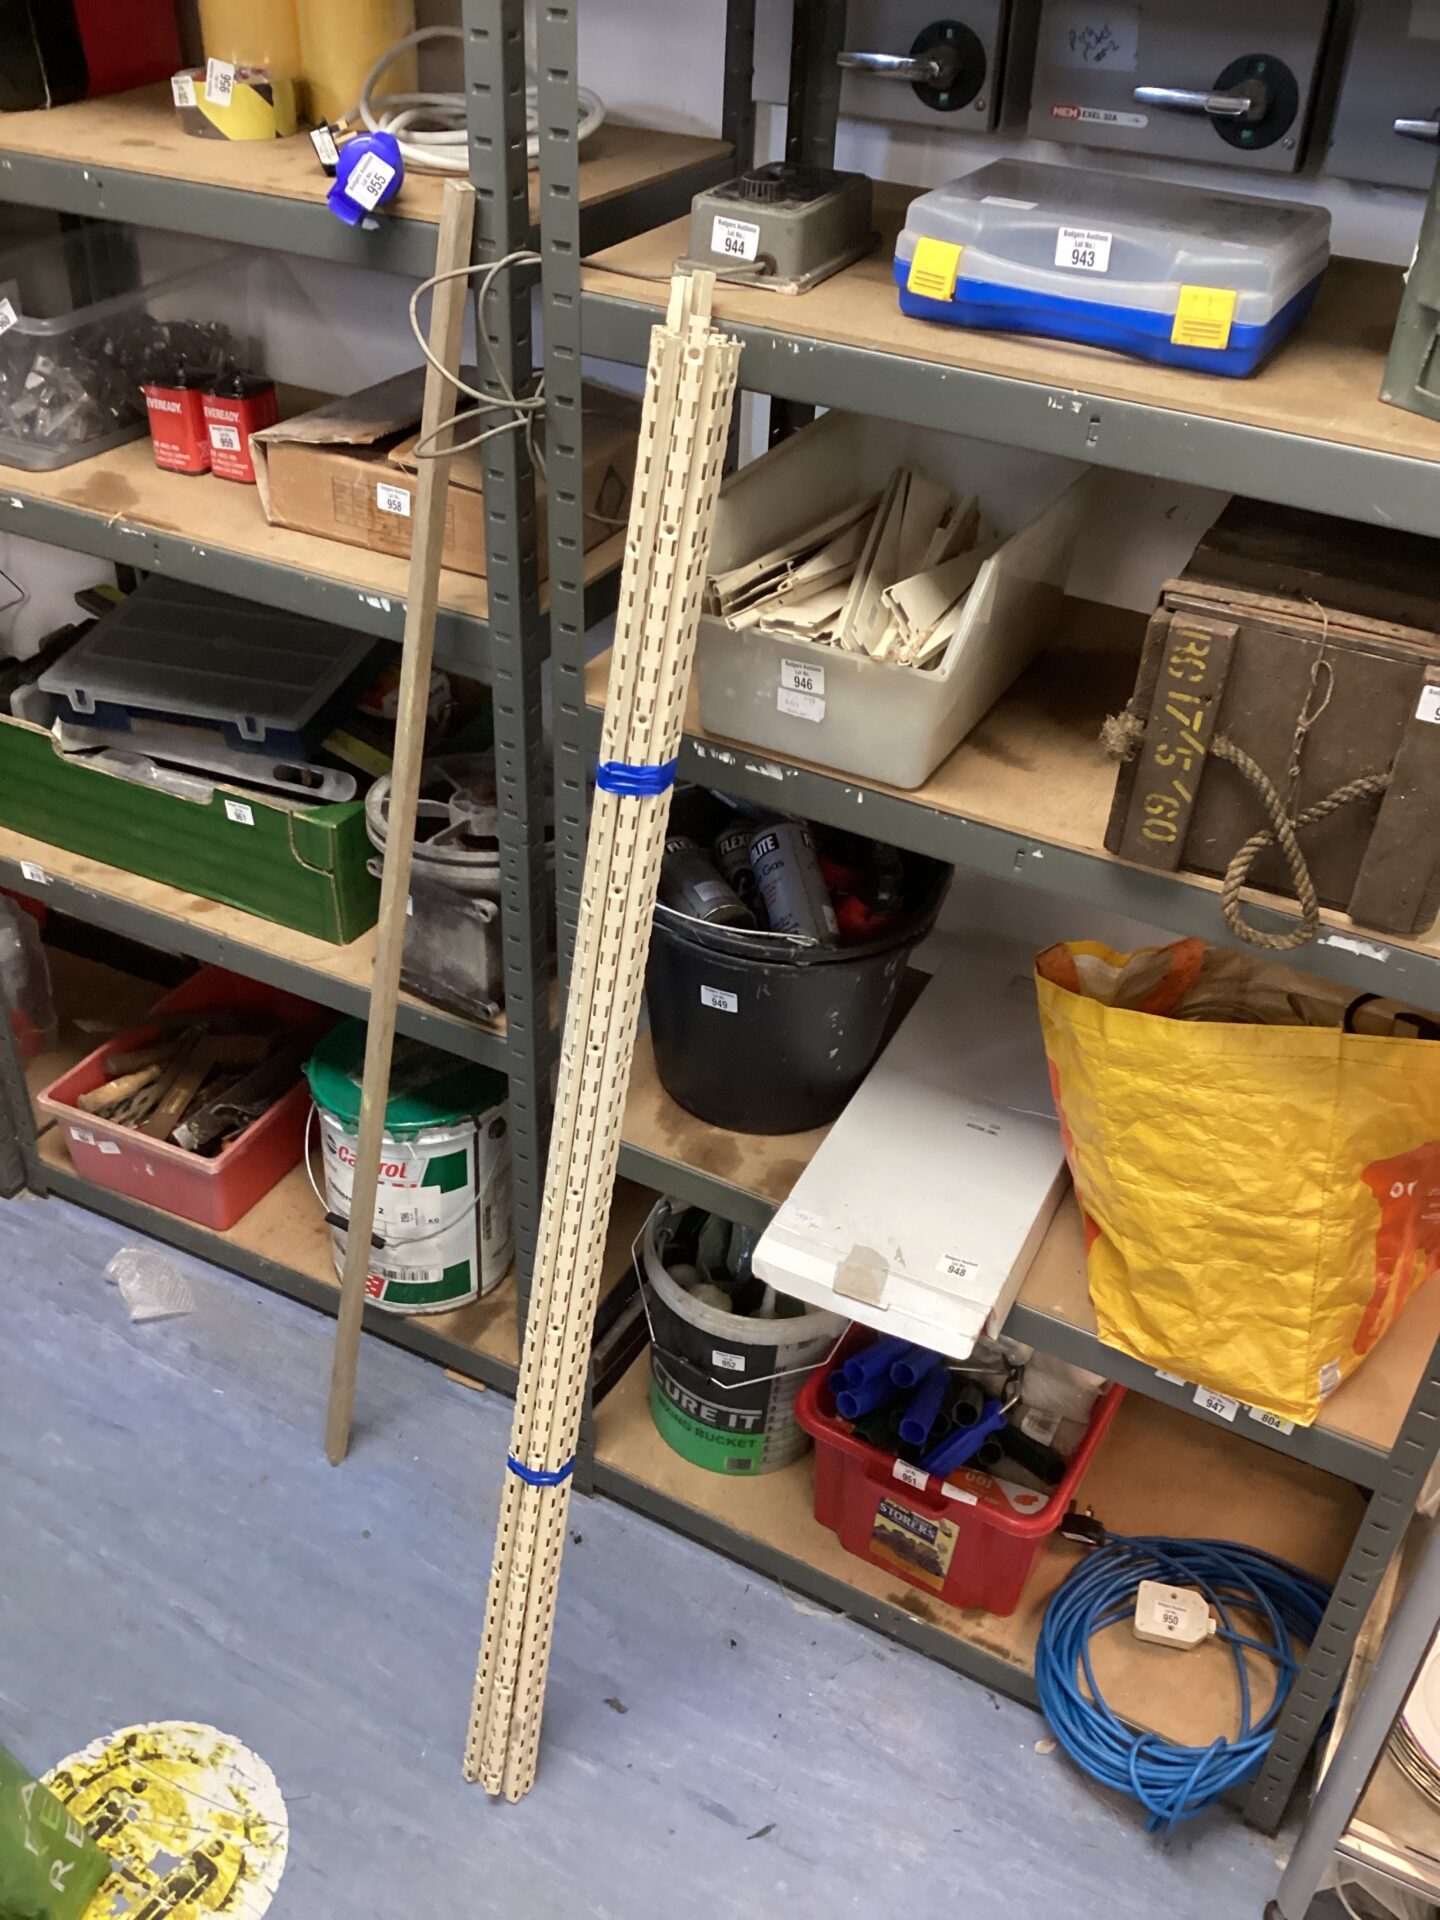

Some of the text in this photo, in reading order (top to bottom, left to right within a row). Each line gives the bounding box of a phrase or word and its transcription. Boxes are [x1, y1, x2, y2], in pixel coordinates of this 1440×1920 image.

[218, 73, 232, 94] 956
[366, 172, 386, 197] 955
[725, 237, 745, 255] 944
[1071, 248, 1096, 268] 943
[387, 498, 402, 512] 958
[794, 675, 813, 691] 946
[762, 859, 785, 875] Gas
[711, 997, 728, 1009] 949
[338, 1145, 409, 1179] Carol
[947, 1265, 967, 1277] 948
[1205, 1398, 1226, 1414] 947
[728, 1413, 761, 1430] IT
[1261, 1412, 1282, 1429] 804
[695, 1428, 757, 1449] BUCKET
[902, 1472, 917, 1486] 951
[879, 1502, 937, 1540] STORERS
[1162, 1613, 1179, 1626] 950
